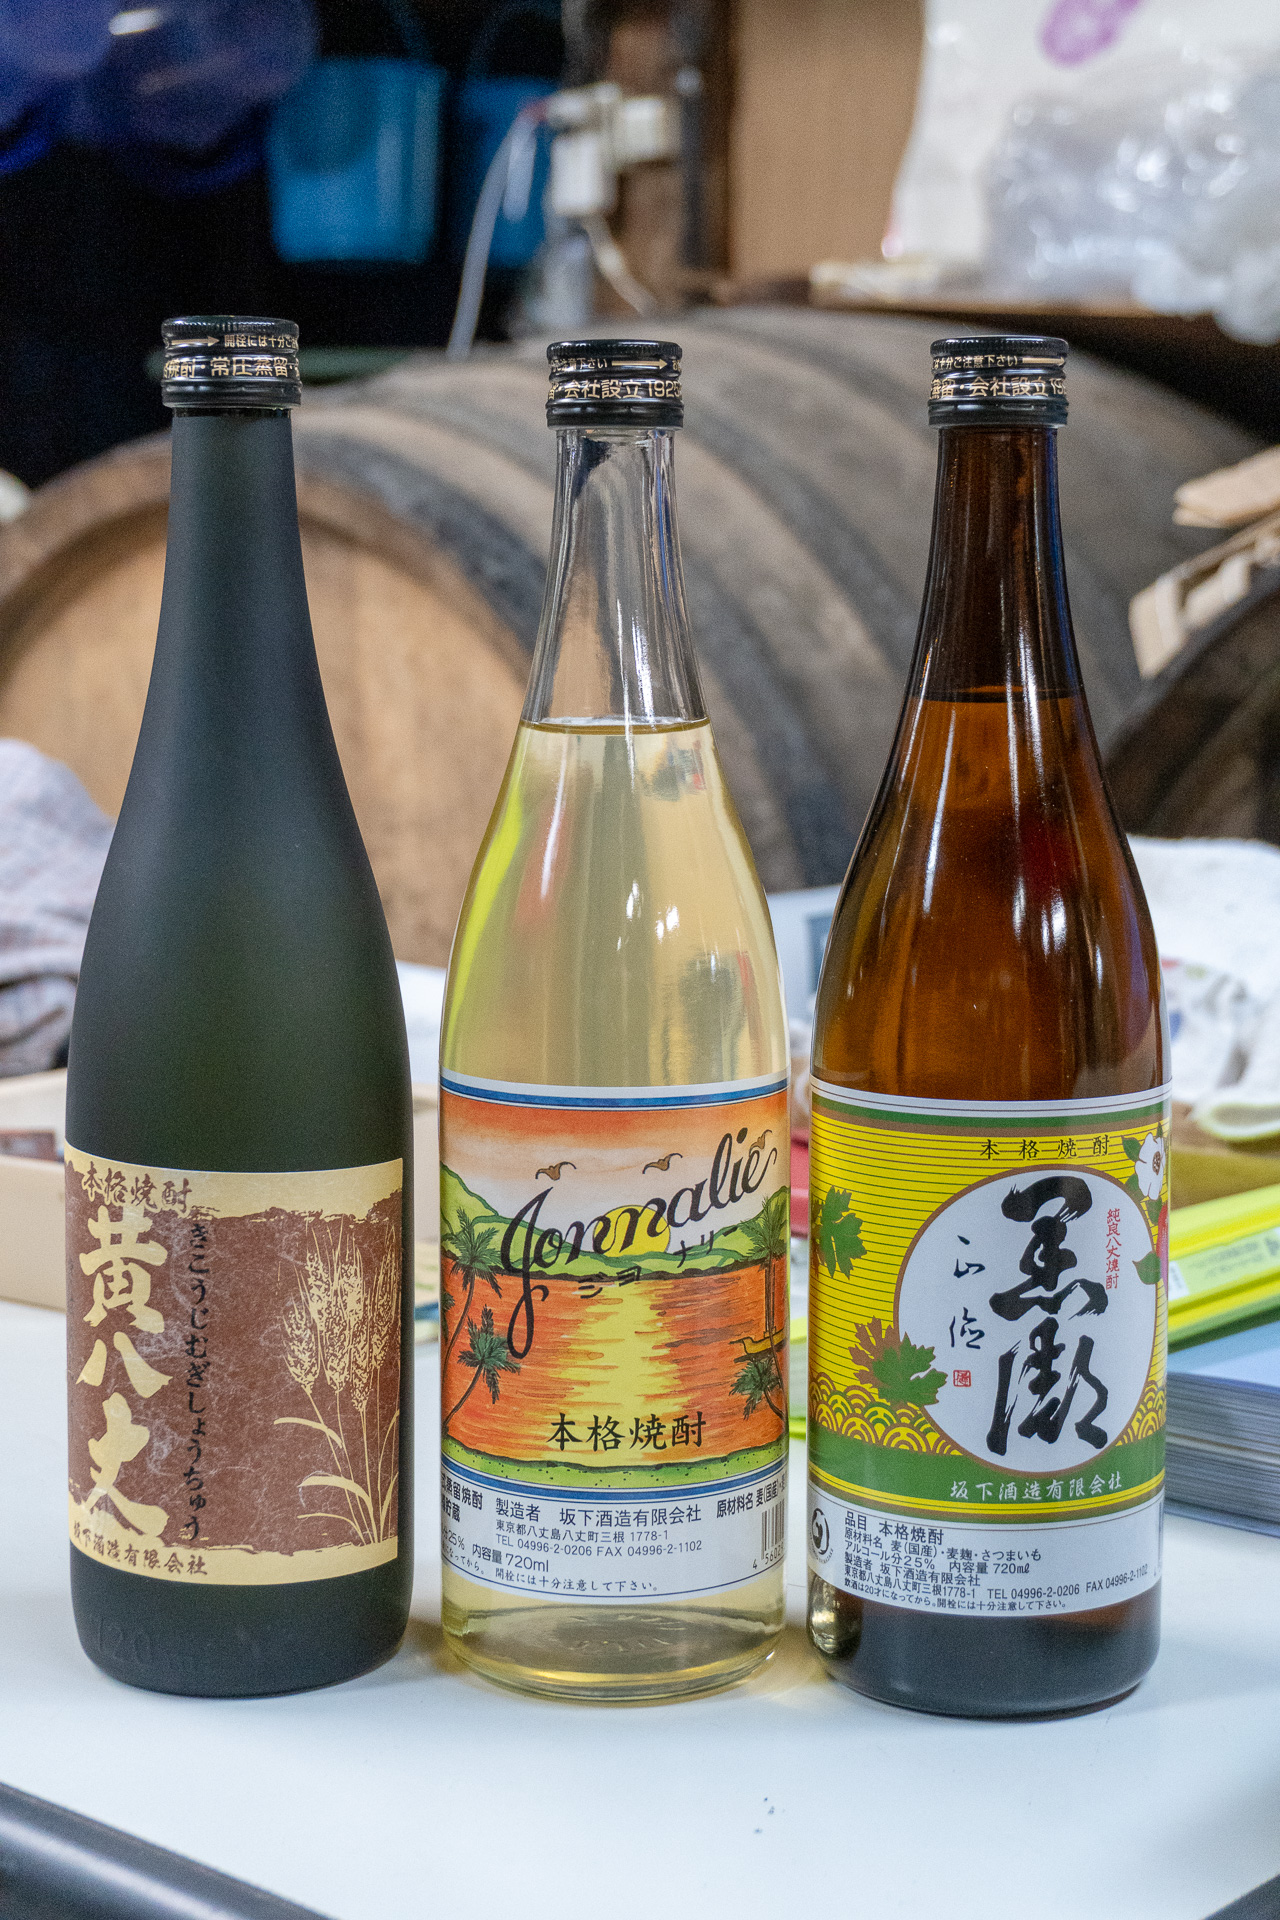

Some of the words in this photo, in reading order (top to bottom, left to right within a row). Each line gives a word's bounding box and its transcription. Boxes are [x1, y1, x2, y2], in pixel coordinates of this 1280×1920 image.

[979, 1135, 1110, 1160] 本格焼酎
[82, 1161, 193, 1214] 本格焼酎
[500, 1127, 778, 1359] Jonnalie
[986, 1175, 1109, 1456] 黒潮
[76, 1205, 173, 1537] 黄八丈
[183, 1222, 210, 1541] きこうじむぎしょうちゅう
[547, 1411, 706, 1453] 本格焼酎
[950, 1471, 1123, 1501] 坂下酒造有限会社
[496, 1497, 541, 1523] 製造者
[559, 1504, 702, 1528] 坂下酒造有限会社
[717, 1491, 753, 1518] 原材料名
[496, 1519, 625, 1543] 東京都八丈島八丈町三根
[630, 1530, 668, 1542] 1778-1
[496, 1534, 514, 1547] TEL
[517, 1538, 593, 1556] 04996-2-0206
[596, 1546, 623, 1557] FAX
[627, 1541, 702, 1557] 04996-2-1102
[844, 1511, 867, 1531] 品目
[879, 1520, 944, 1546] 本格焼酎
[844, 1527, 882, 1549] 原材料名
[472, 1543, 502, 1564] 内容量
[505, 1553, 549, 1572] 720ml
[844, 1540, 935, 1569] アルコール分25%
[949, 1560, 988, 1574] 内容量
[844, 1552, 873, 1571] 製造者
[879, 1562, 980, 1586] 坂下酒造有限会社
[495, 1567, 657, 1593] 開栓には十分注意して下さい。
[844, 1564, 976, 1599] 東京都八丈島八丈町三根1778-1
[987, 1588, 1007, 1600] TEL
[1010, 1583, 1080, 1599] 04996-2-0206
[1085, 1579, 1104, 1593] FAX
[1105, 1563, 1149, 1589] 04996-2-1102
